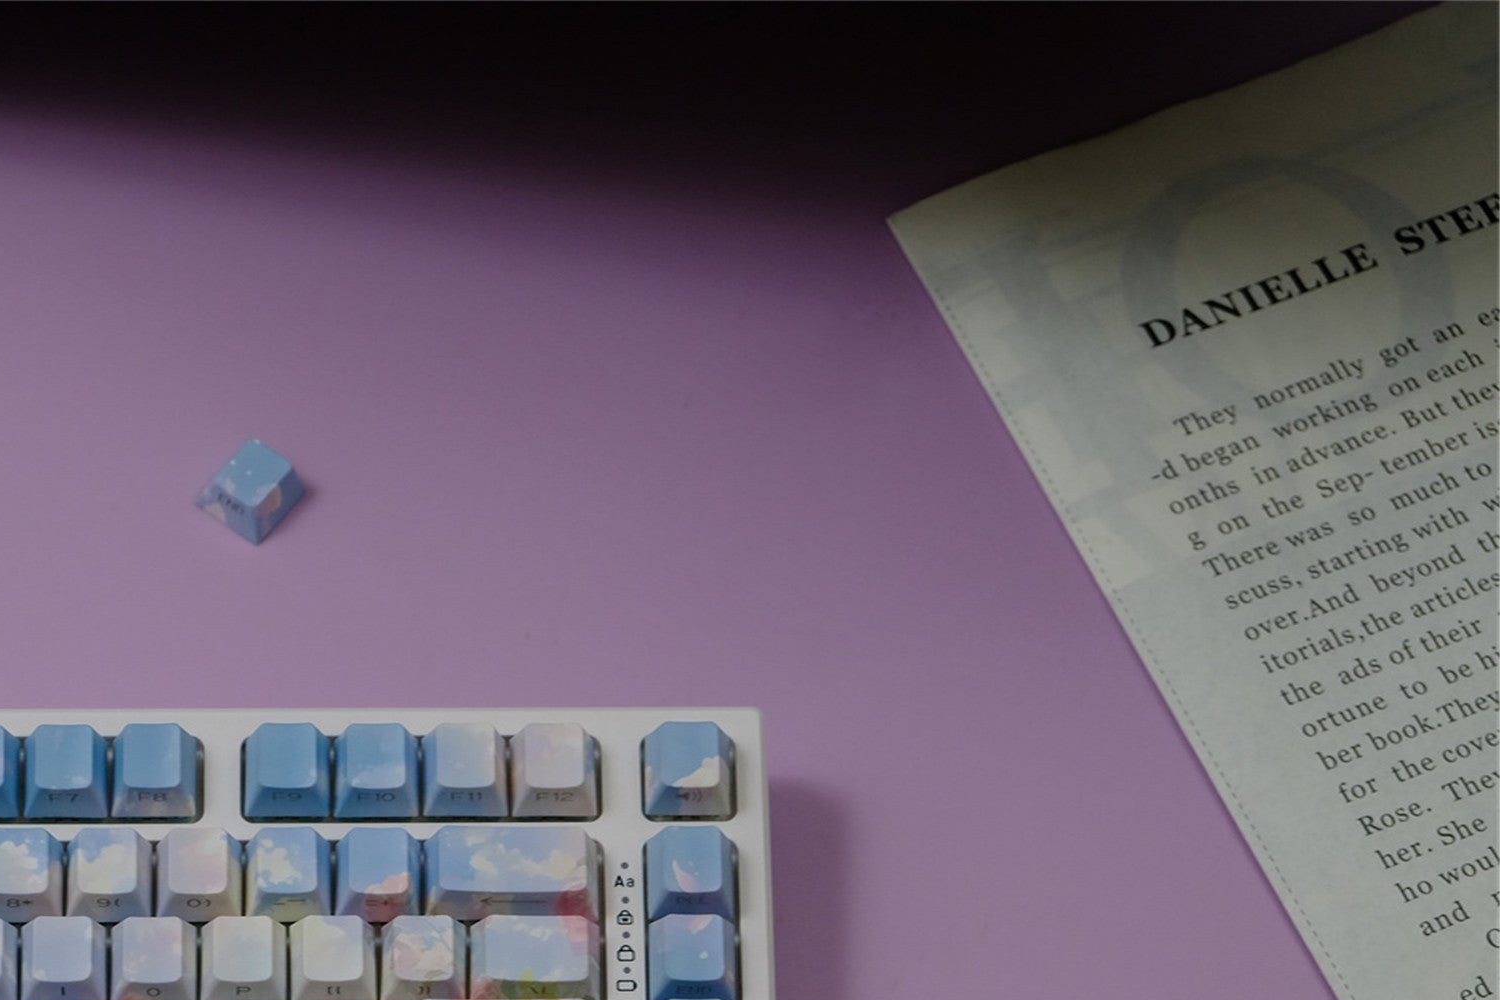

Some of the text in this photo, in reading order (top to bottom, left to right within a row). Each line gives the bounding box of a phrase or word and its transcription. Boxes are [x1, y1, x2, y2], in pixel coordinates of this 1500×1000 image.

[1139, 242, 1379, 348] DANIELLE
[1172, 405, 1236, 436] They
[1253, 358, 1363, 410] normally
[1379, 336, 1421, 368] got
[1432, 322, 1466, 344] an
[1183, 435, 1261, 472] began
[1271, 393, 1379, 439] working
[1388, 376, 1422, 398] on
[1426, 349, 1485, 383] each
[1169, 480, 1241, 515] onths
[1250, 466, 1281, 485] in
[1286, 425, 1397, 474] advance.
[1399, 401, 1449, 429] But
[1187, 531, 1207, 551] g
[1217, 515, 1251, 535] on
[1261, 494, 1305, 519] the
[1315, 471, 1374, 499] Sep-
[1379, 431, 1469, 475] tember
[1201, 462, 1493, 577] There was so much to
[1224, 575, 1303, 610] scuss,
[1306, 533, 1410, 580] starting
[1411, 507, 1471, 539] with
[1368, 544, 1466, 593] beyond
[1280, 619, 1482, 706] the ads of their
[1301, 696, 1388, 738] ortune
[1399, 680, 1428, 700] to
[1436, 663, 1474, 685] be
[1315, 743, 1363, 771] ber
[49, 793, 79, 803] F7
[137, 792, 168, 802] F8
[272, 792, 303, 802] F9
[357, 792, 396, 802] F10
[451, 791, 483, 801] F11
[536, 791, 574, 801] F12
[1338, 777, 1378, 804] for
[1391, 756, 1437, 783] the
[1356, 802, 1432, 837] Rose.
[1374, 818, 1488, 870] her. She
[614, 875, 635, 888] Aa
[1394, 880, 1434, 904] ho
[1419, 900, 1471, 937] and
[236, 986, 252, 997] P
